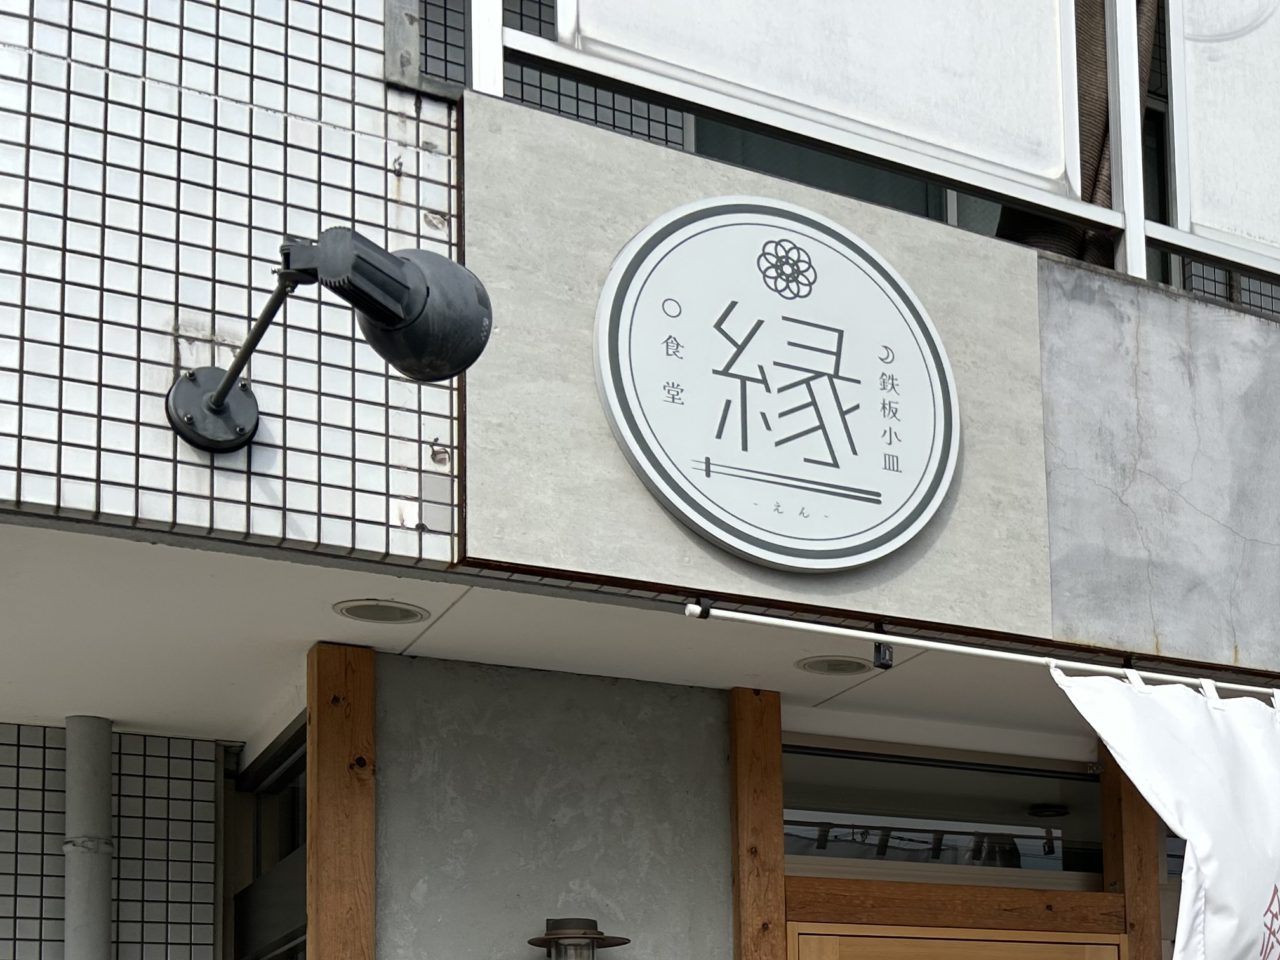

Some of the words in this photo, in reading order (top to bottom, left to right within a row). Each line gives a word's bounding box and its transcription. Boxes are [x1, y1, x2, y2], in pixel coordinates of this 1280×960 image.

[661, 334, 685, 406] 食堂
[712, 300, 863, 470] 縁
[878, 371, 904, 474] 鉄板小皿
